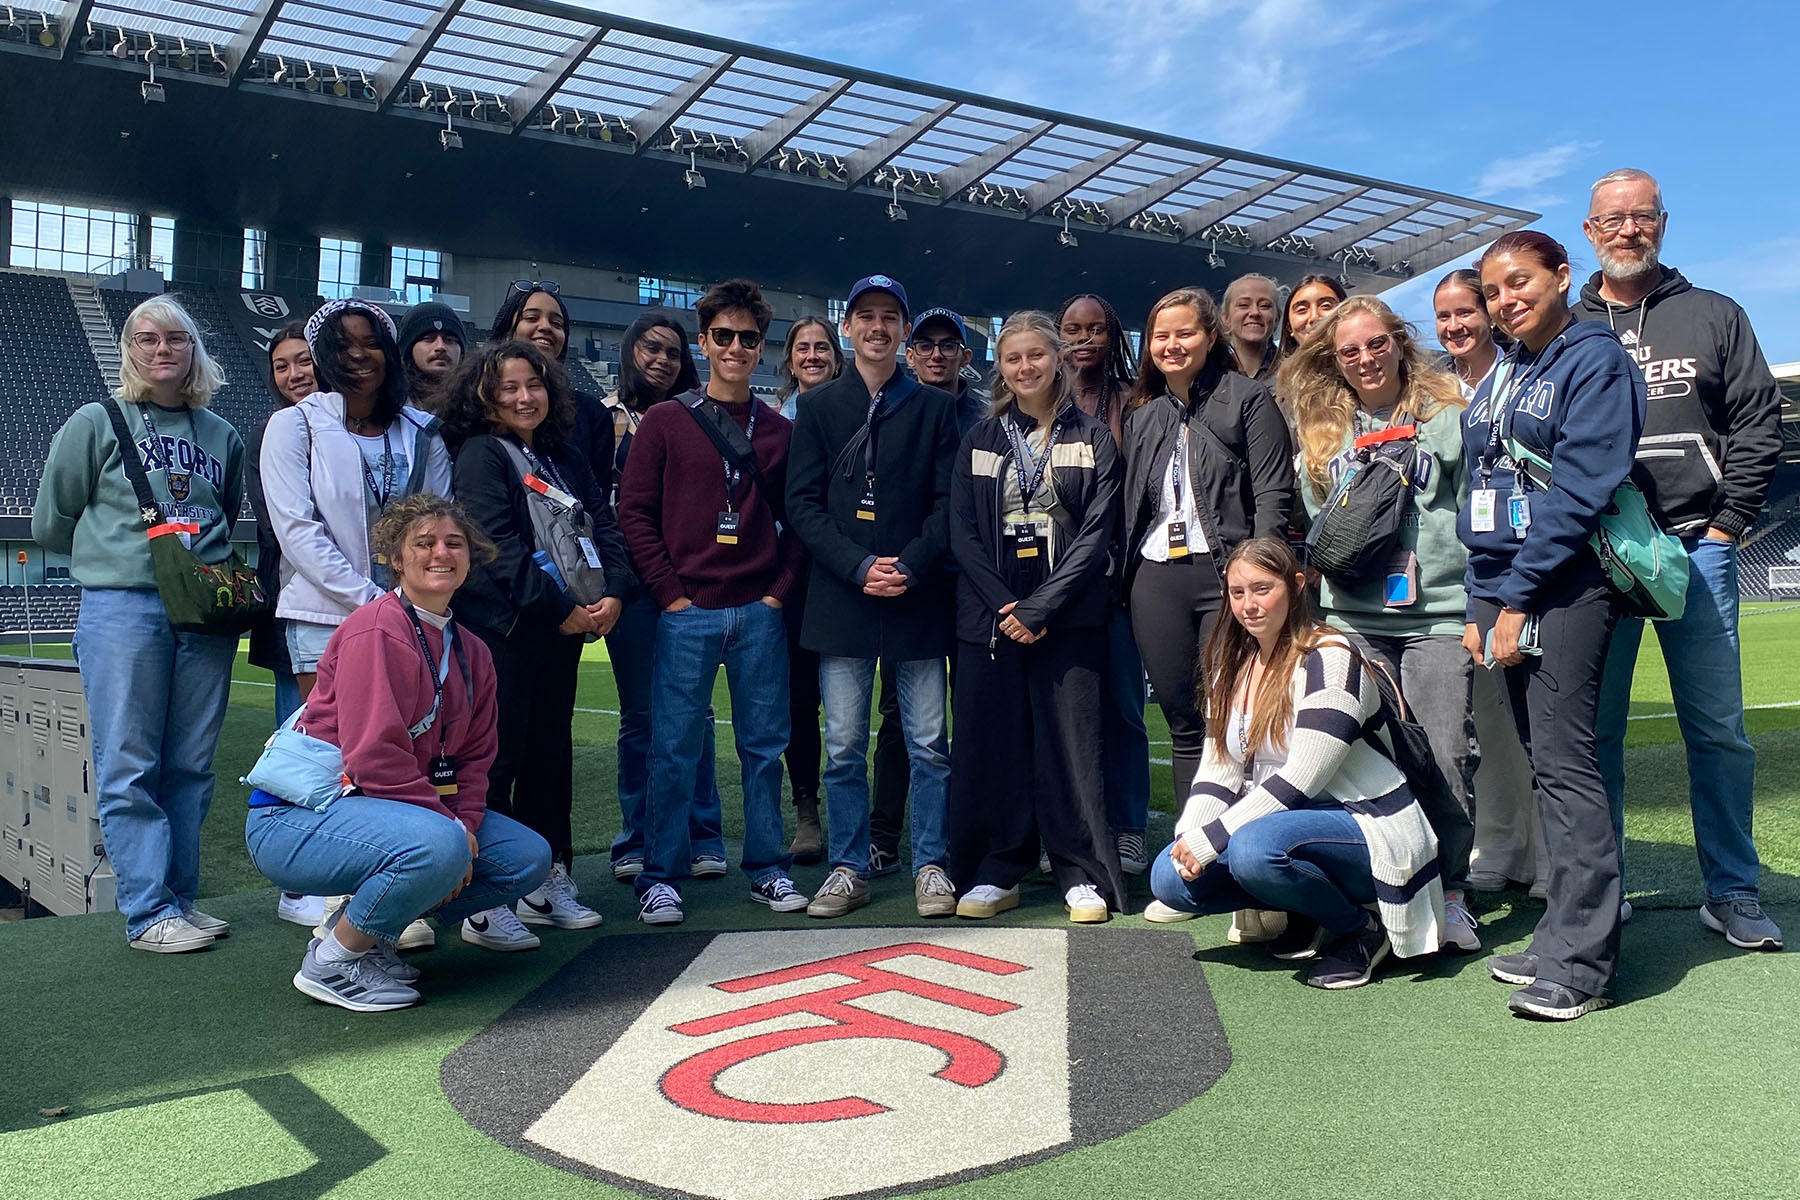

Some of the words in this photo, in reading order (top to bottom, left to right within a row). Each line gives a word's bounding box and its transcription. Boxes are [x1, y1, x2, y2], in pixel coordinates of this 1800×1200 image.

[1489, 422, 1500, 447] TOURS
[121, 434, 223, 493] XFORD
[366, 472, 377, 491] TOURS
[1031, 471, 1041, 490] TOURS
[156, 502, 213, 520] IVERSITY
[1169, 534, 1185, 542] GUEST
[419, 635, 431, 659] CRAVEN
[428, 660, 442, 687] COTTAGE
[434, 770, 453, 778] GUEST
